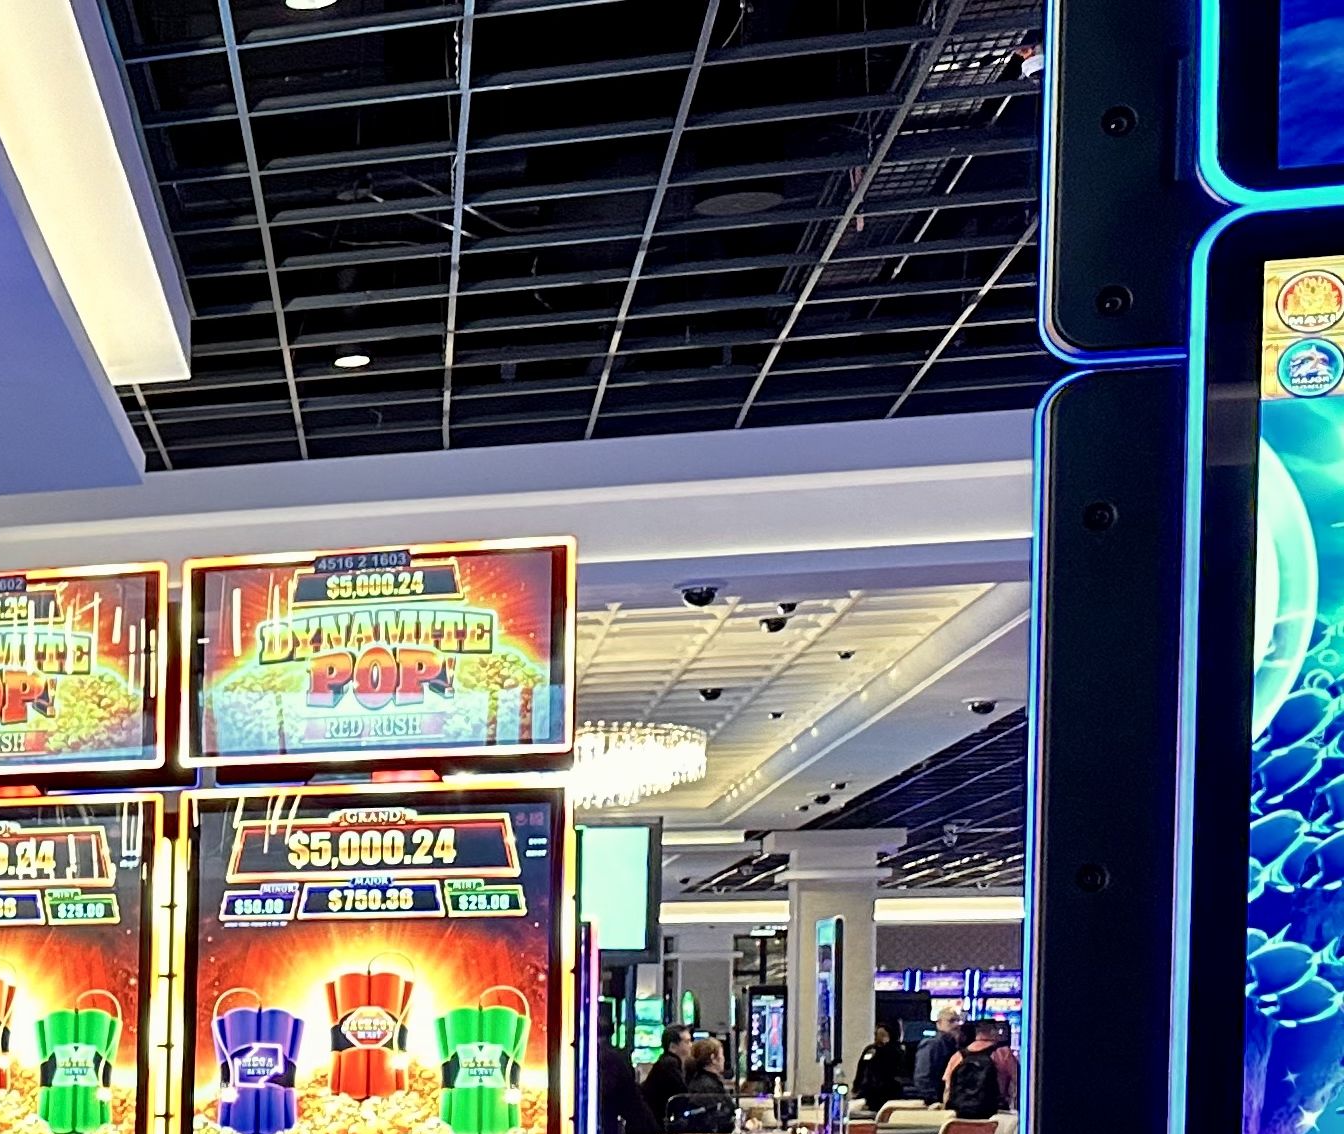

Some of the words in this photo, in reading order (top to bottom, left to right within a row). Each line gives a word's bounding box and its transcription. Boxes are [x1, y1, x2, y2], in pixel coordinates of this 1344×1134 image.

[1288, 313, 1337, 327] MAXI
[317, 555, 354, 570] 4516
[358, 555, 368, 568] 2
[371, 552, 408, 568] 1603
[326, 571, 425, 600] $5,000.24
[259, 609, 494, 665] DYNAMITE
[306, 646, 455, 711] POP!
[325, 718, 363, 740] RED
[371, 713, 422, 738] RUSH
[347, 810, 400, 823] GRAND
[287, 828, 457, 870] $5,000.24
